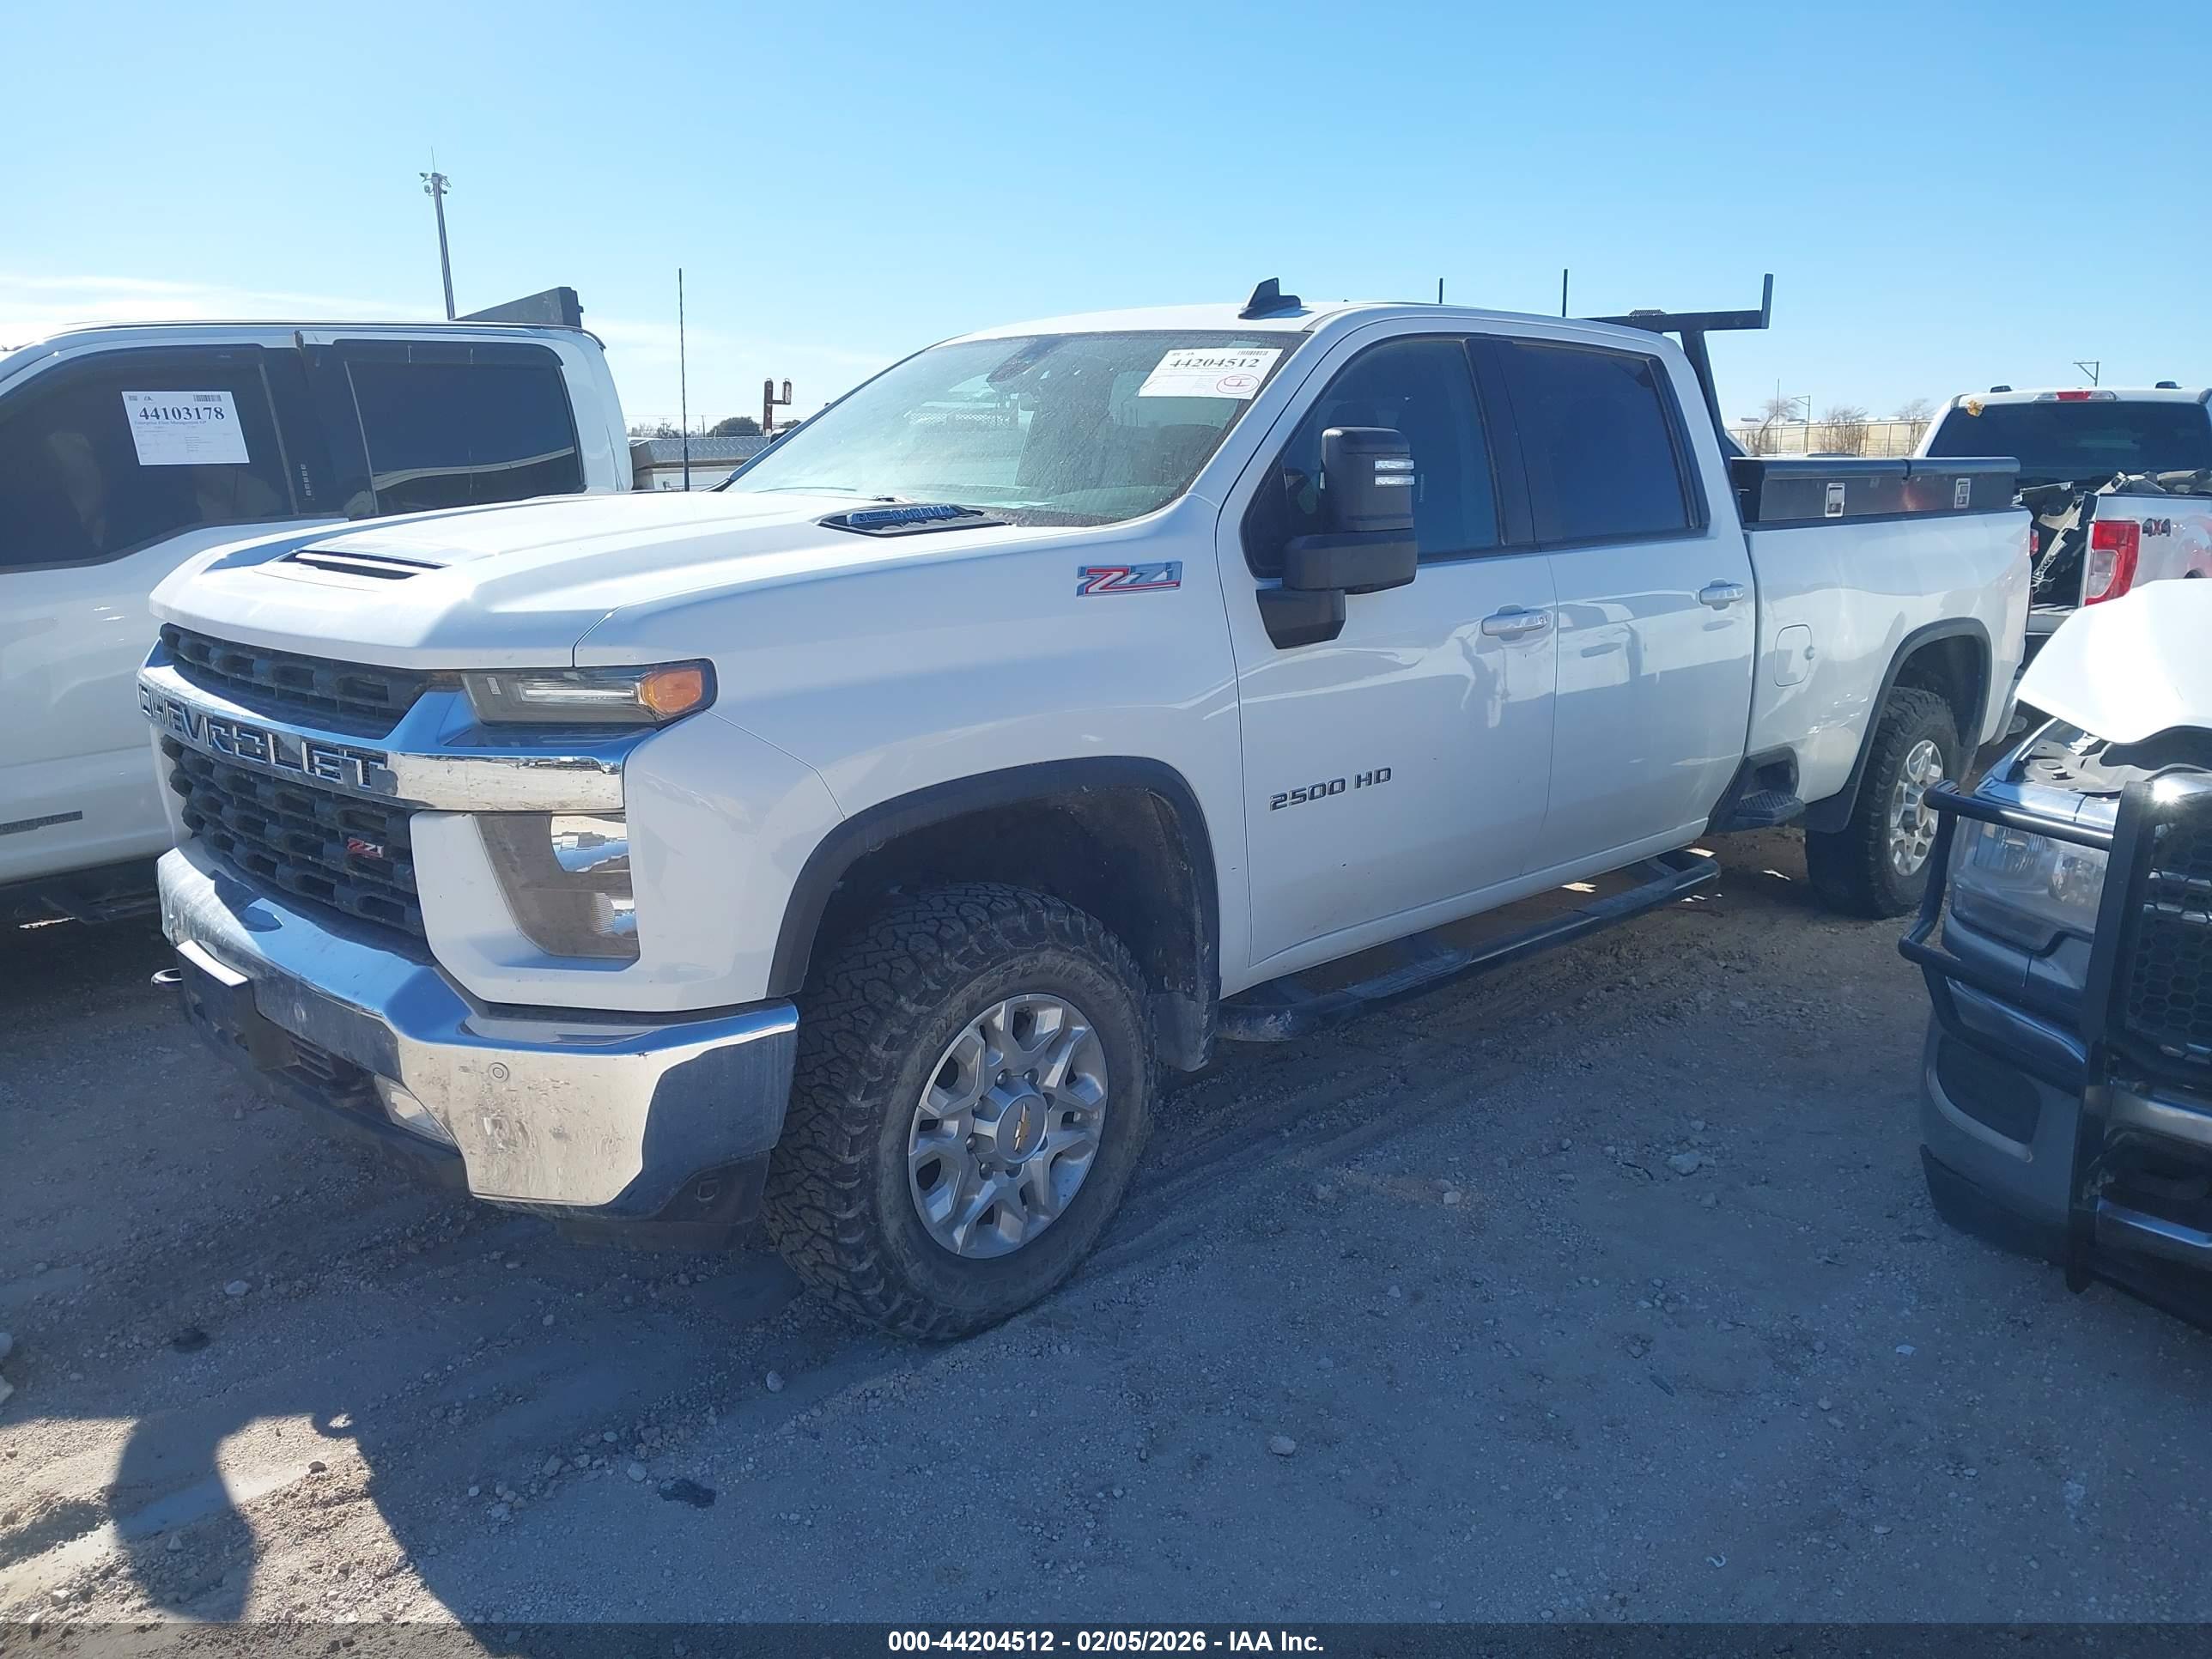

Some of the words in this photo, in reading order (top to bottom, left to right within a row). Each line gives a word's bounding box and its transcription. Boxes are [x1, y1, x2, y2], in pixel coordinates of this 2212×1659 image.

[1170, 358, 1260, 368] 44204512
[139, 406, 225, 421] 44103178
[1076, 561, 1183, 598] Z71
[137, 684, 388, 788] CHEVROLET
[1269, 777, 1346, 811] 2500
[1354, 767, 1392, 789] HD
